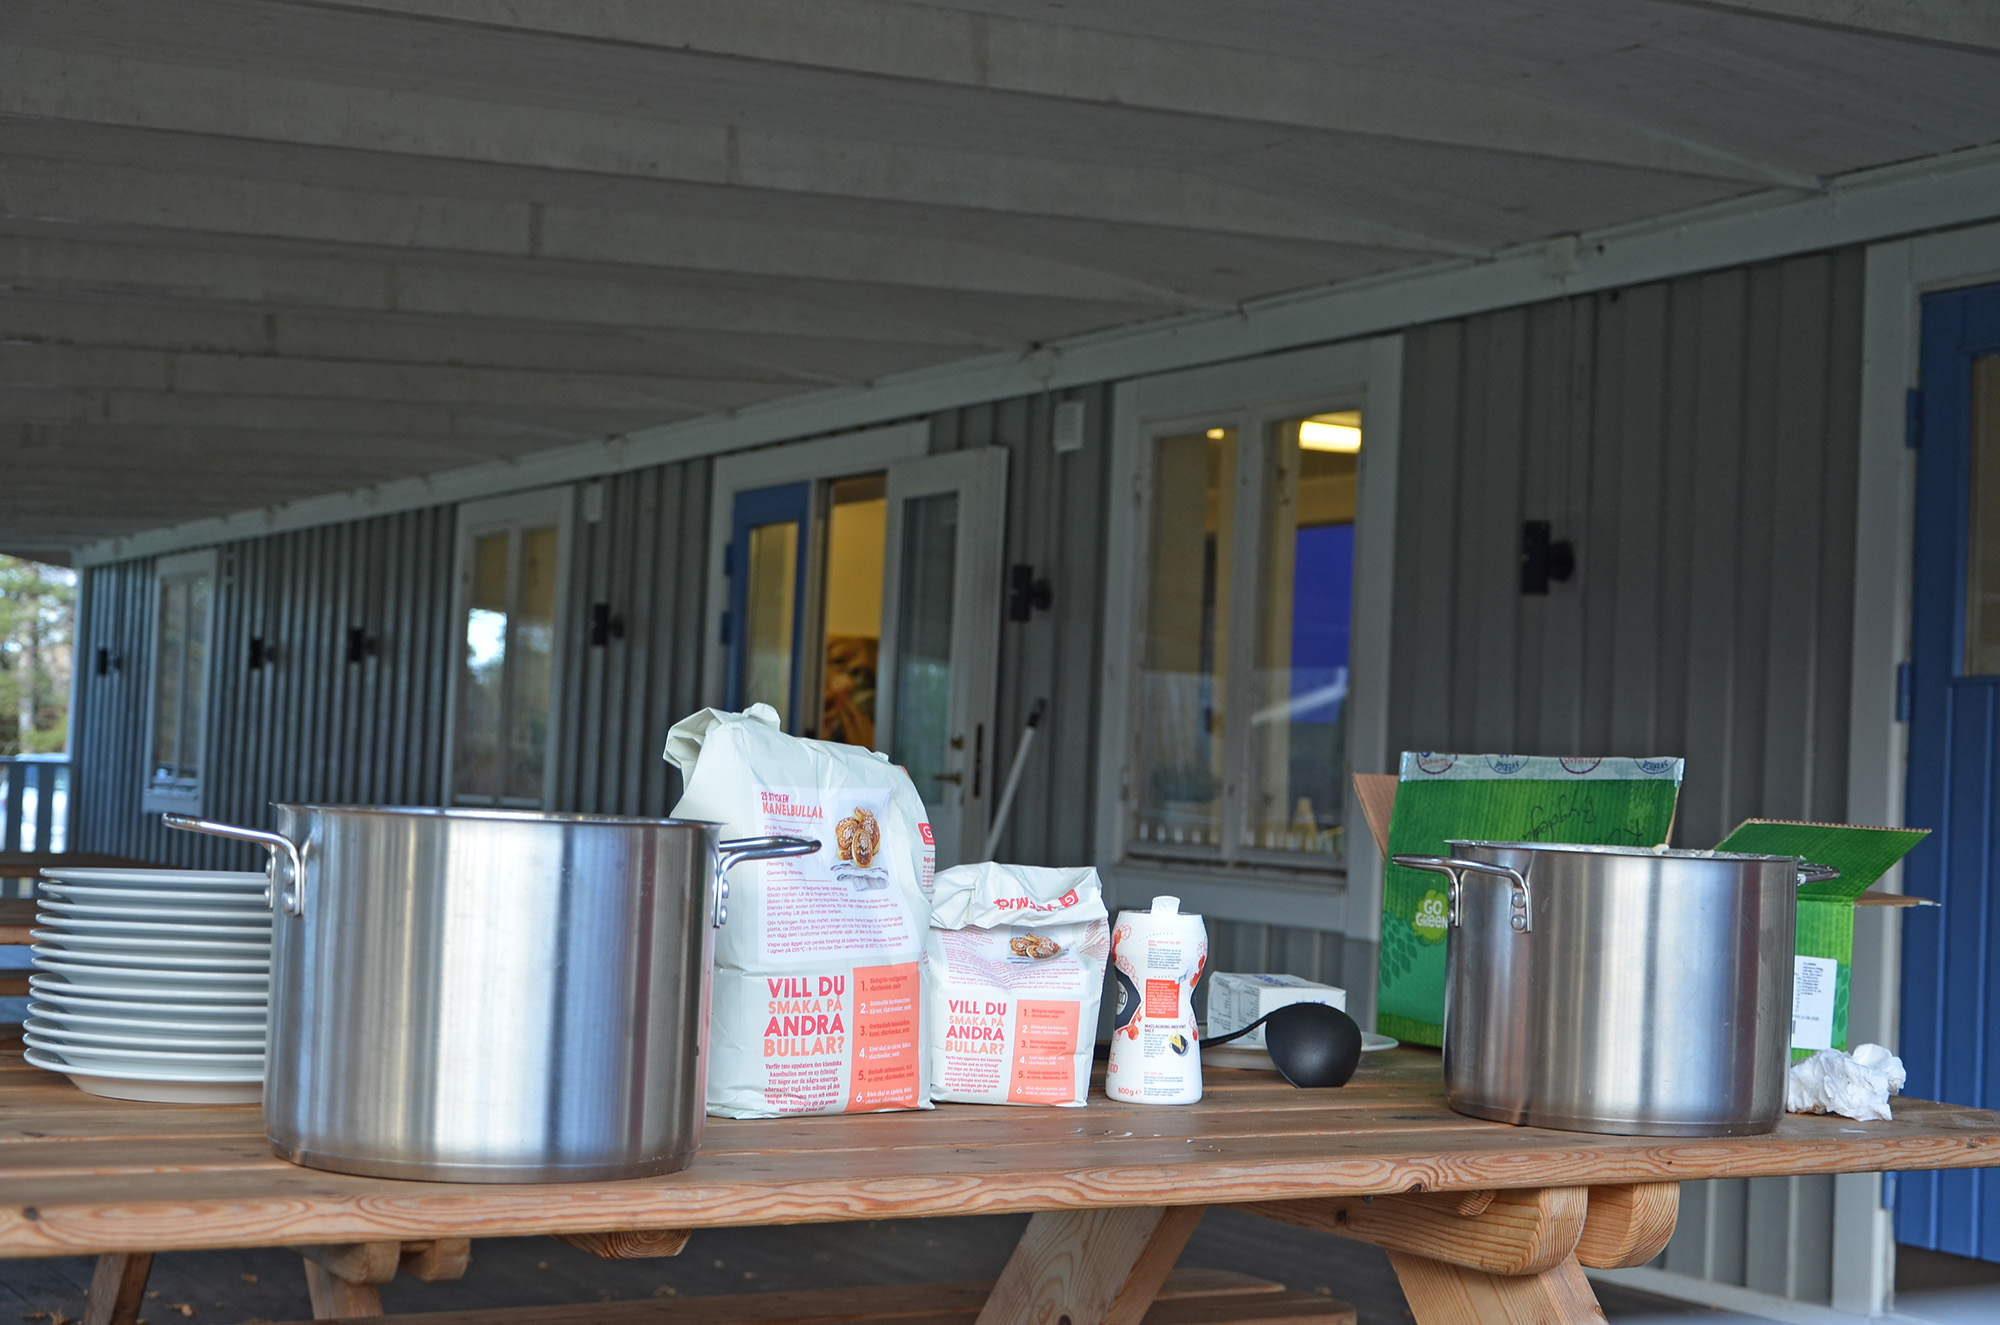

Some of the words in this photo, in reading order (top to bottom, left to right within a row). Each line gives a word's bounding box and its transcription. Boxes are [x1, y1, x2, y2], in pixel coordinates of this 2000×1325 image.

[1495, 760, 1519, 772] SVERIGE
[1643, 760, 1668, 772] SVERIGE
[761, 792, 767, 801] 25
[1424, 899, 1443, 916] GO
[767, 978, 812, 998] VILL
[819, 975, 845, 997] DU
[861, 981, 868, 991] 1.
[768, 999, 821, 1014] SMAKA
[827, 995, 843, 1012] PÅ
[860, 1003, 868, 1014] 2.
[949, 1000, 980, 1014] VILL
[985, 1002, 1007, 1016] DU
[1024, 1009, 1029, 1017] 1.
[764, 1013, 844, 1037] ANDRA
[949, 1016, 987, 1026] SMAKA
[991, 1016, 1004, 1027] PÅ
[860, 1025, 867, 1036] 3.
[946, 1025, 1004, 1041] ANDRA
[1022, 1025, 1029, 1033] 2.
[764, 1036, 845, 1057] BULLAR?
[945, 1040, 1005, 1055] BULLAR?
[1021, 1040, 1028, 1048] 3.
[859, 1048, 867, 1058] 4.
[1019, 1056, 1027, 1064] 4.
[858, 1070, 866, 1080] 5.
[1018, 1071, 1025, 1079] 5.
[1016, 1086, 1024, 1094] 6.
[1118, 1086, 1129, 1094] 600
[856, 1092, 864, 1102] 6.
